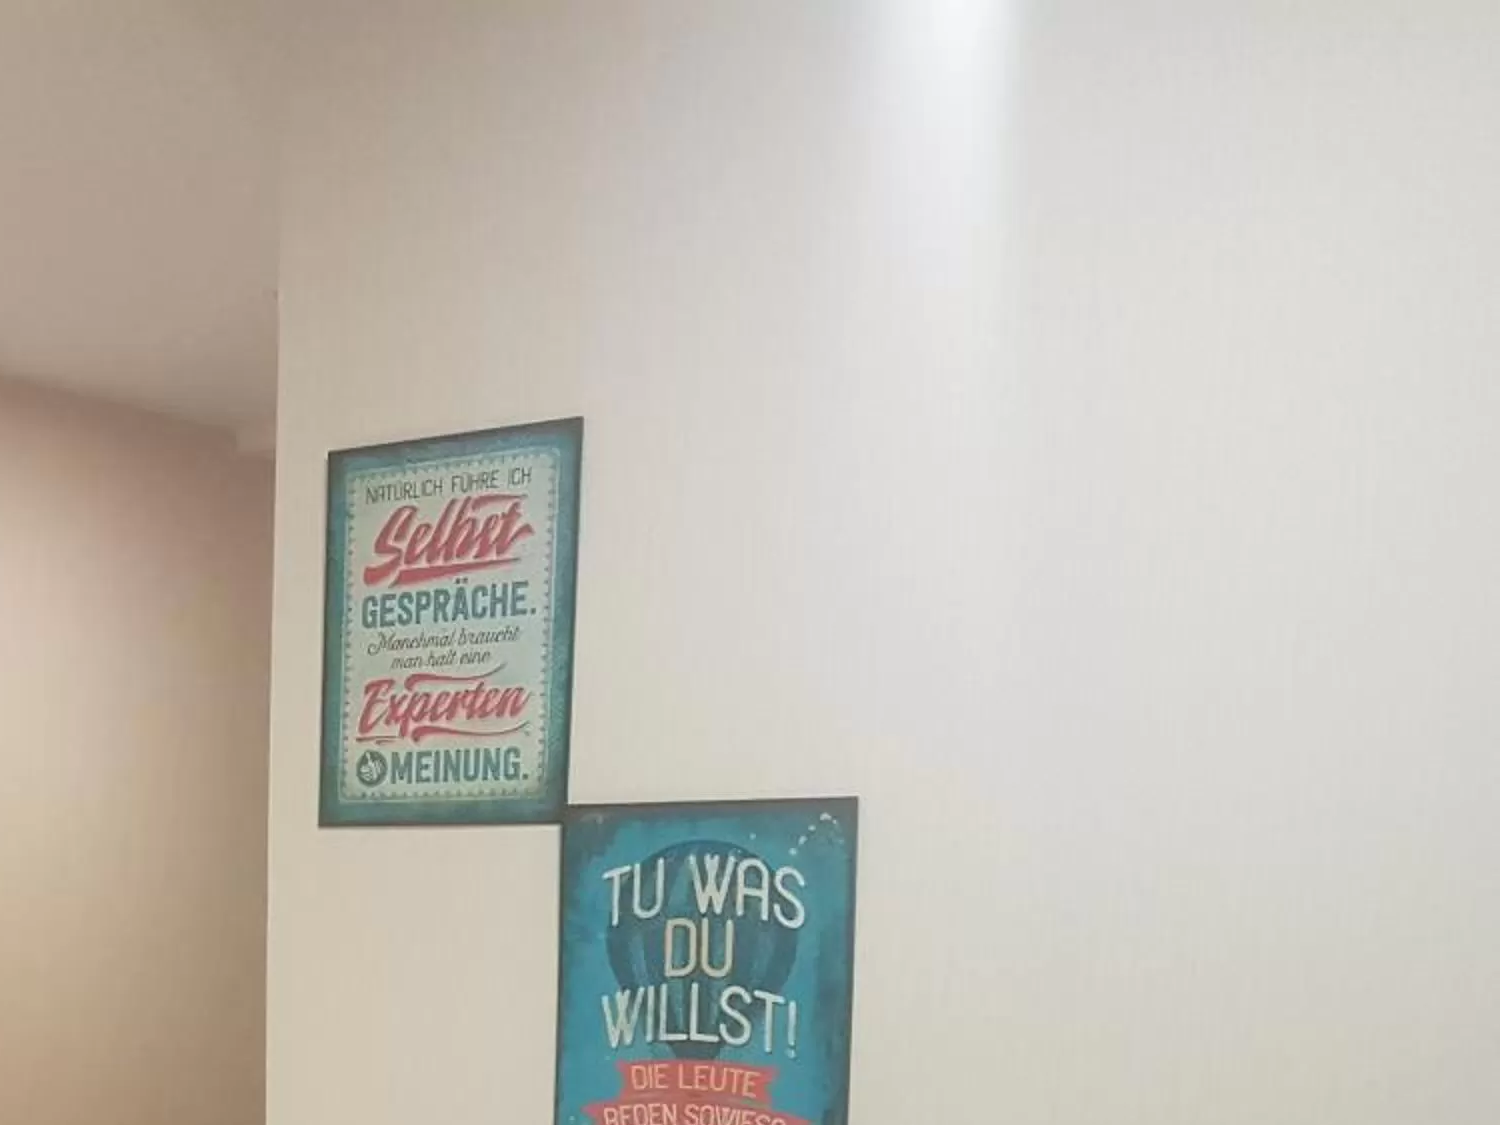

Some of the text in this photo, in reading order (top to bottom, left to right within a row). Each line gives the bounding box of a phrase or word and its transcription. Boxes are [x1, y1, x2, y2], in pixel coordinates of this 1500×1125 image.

[365, 466, 533, 505] NATÜRLICH FÜHRE ICH
[364, 494, 535, 585] Selbst
[362, 577, 537, 628] GESPRÄCHE.
[367, 625, 520, 656] Manchmal braucht
[391, 656, 423, 669] man
[460, 650, 491, 665] eine
[357, 676, 531, 739] Experten
[389, 748, 529, 785] MEINUNG.
[602, 852, 806, 929] TU WAS
[663, 917, 734, 979] DU
[601, 982, 797, 1059] WILLST!
[630, 1063, 761, 1099] DIE LEUTE
